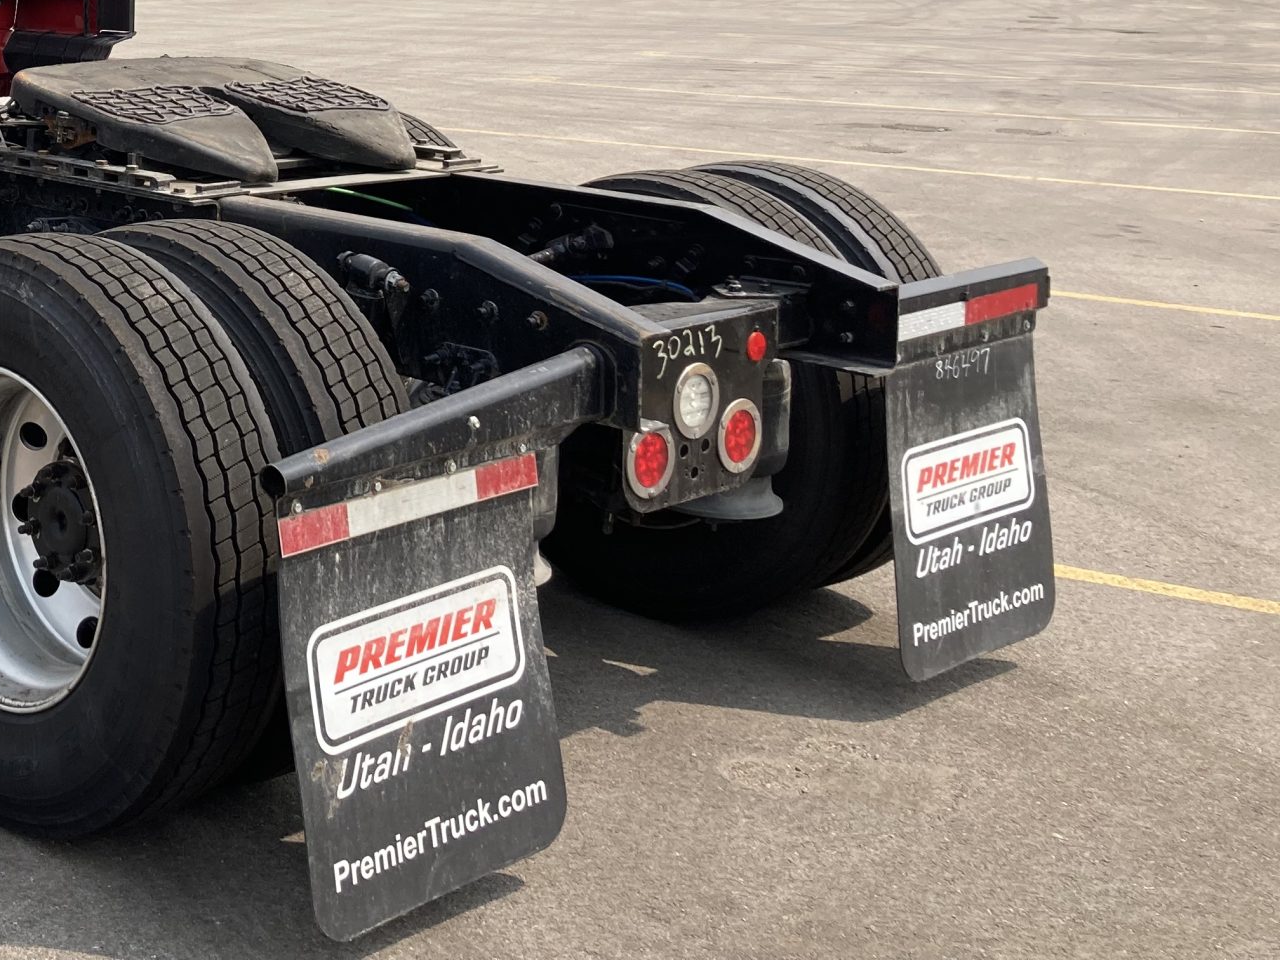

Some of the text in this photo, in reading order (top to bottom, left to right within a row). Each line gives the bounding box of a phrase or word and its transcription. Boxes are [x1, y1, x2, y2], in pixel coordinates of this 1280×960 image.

[652, 324, 723, 380] 30213
[935, 347, 991, 380] 846497
[917, 442, 1016, 494] PREMIER
[926, 477, 1013, 517] TRUCK GROUP
[916, 536, 963, 579] Utah
[979, 517, 1033, 557] Idaho
[333, 598, 497, 686] PREMIER
[913, 583, 1044, 647] PremierTruck.com
[350, 645, 491, 714] TRUCK GROUP
[336, 739, 412, 800] Utah
[439, 697, 524, 757] Idaho
[333, 780, 548, 894] PremierTruck.com
